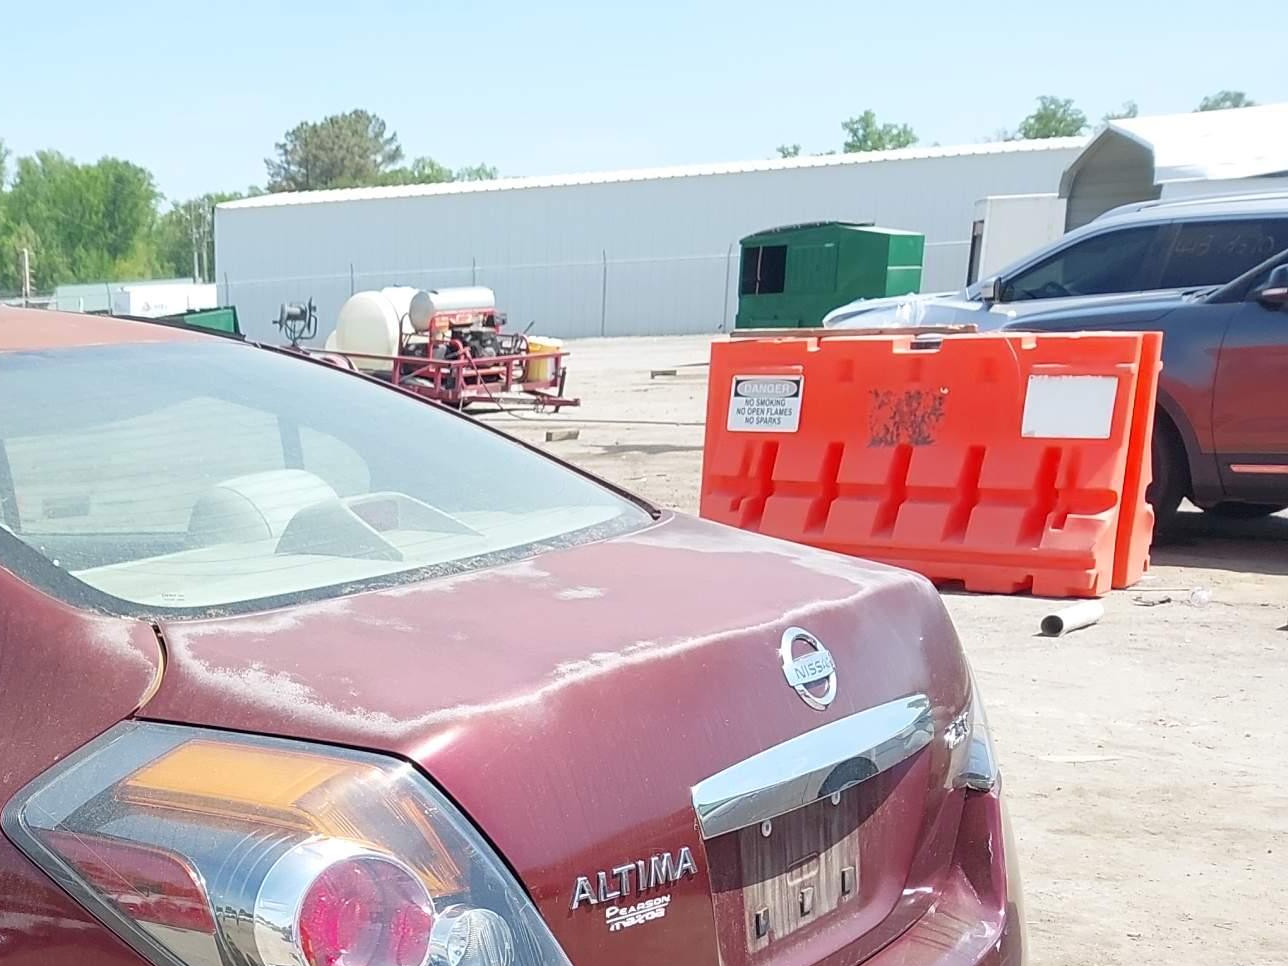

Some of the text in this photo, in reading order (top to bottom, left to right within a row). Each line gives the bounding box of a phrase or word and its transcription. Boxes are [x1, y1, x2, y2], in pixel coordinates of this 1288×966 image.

[744, 383, 790, 394] DANGER
[745, 399, 786, 407] NO SMOKING
[736, 407, 793, 416] NO OPEN FLAMES
[744, 416, 782, 425] NO SPARKS
[569, 846, 699, 912] ALTIMA
